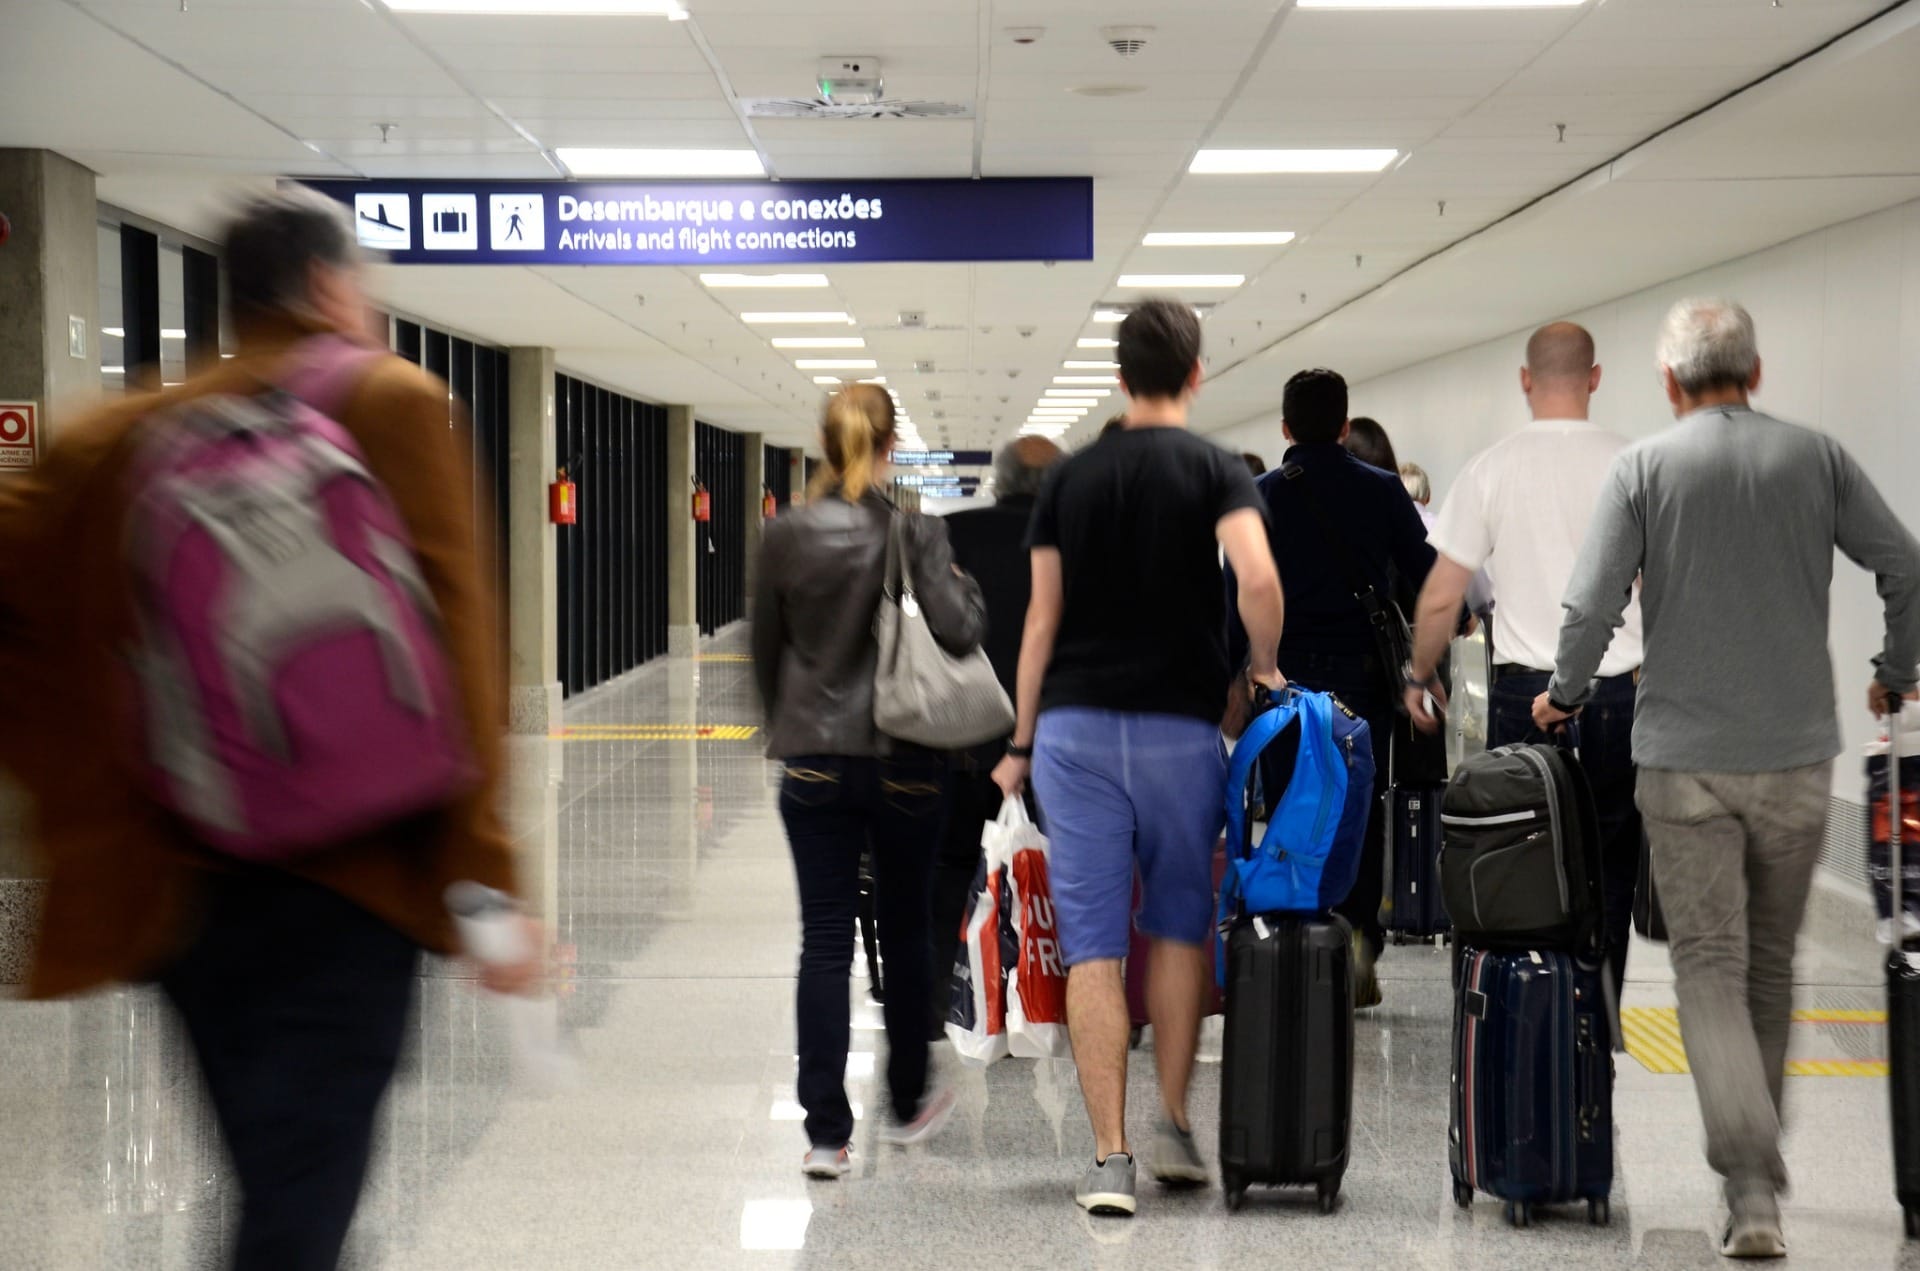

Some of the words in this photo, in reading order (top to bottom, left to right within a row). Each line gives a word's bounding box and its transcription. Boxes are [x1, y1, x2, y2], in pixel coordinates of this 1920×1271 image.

[558, 194, 734, 226] Desembarque
[740, 201, 755, 219] e
[761, 192, 883, 220] conexões
[558, 228, 632, 250] Arrivals
[636, 228, 674, 250] and
[679, 227, 732, 254] flight
[736, 228, 856, 250] connections
